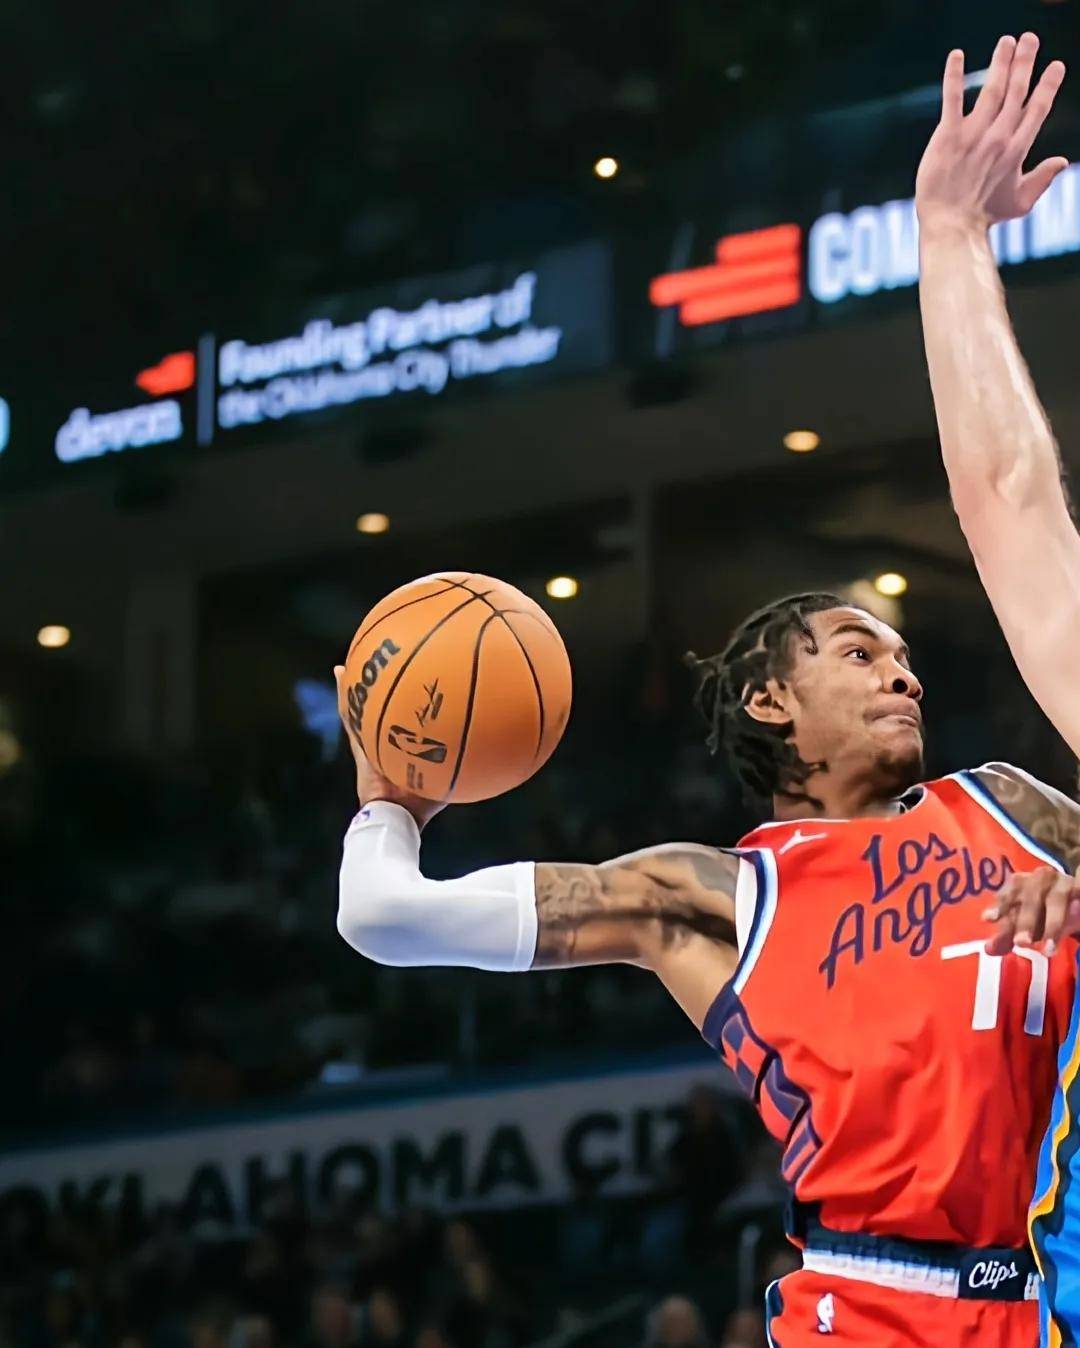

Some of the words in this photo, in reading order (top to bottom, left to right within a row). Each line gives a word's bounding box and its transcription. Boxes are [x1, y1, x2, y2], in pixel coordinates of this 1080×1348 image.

[219, 318, 370, 387] Founding
[366, 294, 493, 355] Partner
[492, 271, 538, 328] of
[55, 399, 184, 463] devon
[861, 832, 957, 904] Los
[968, 1260, 1019, 1290] Clips
